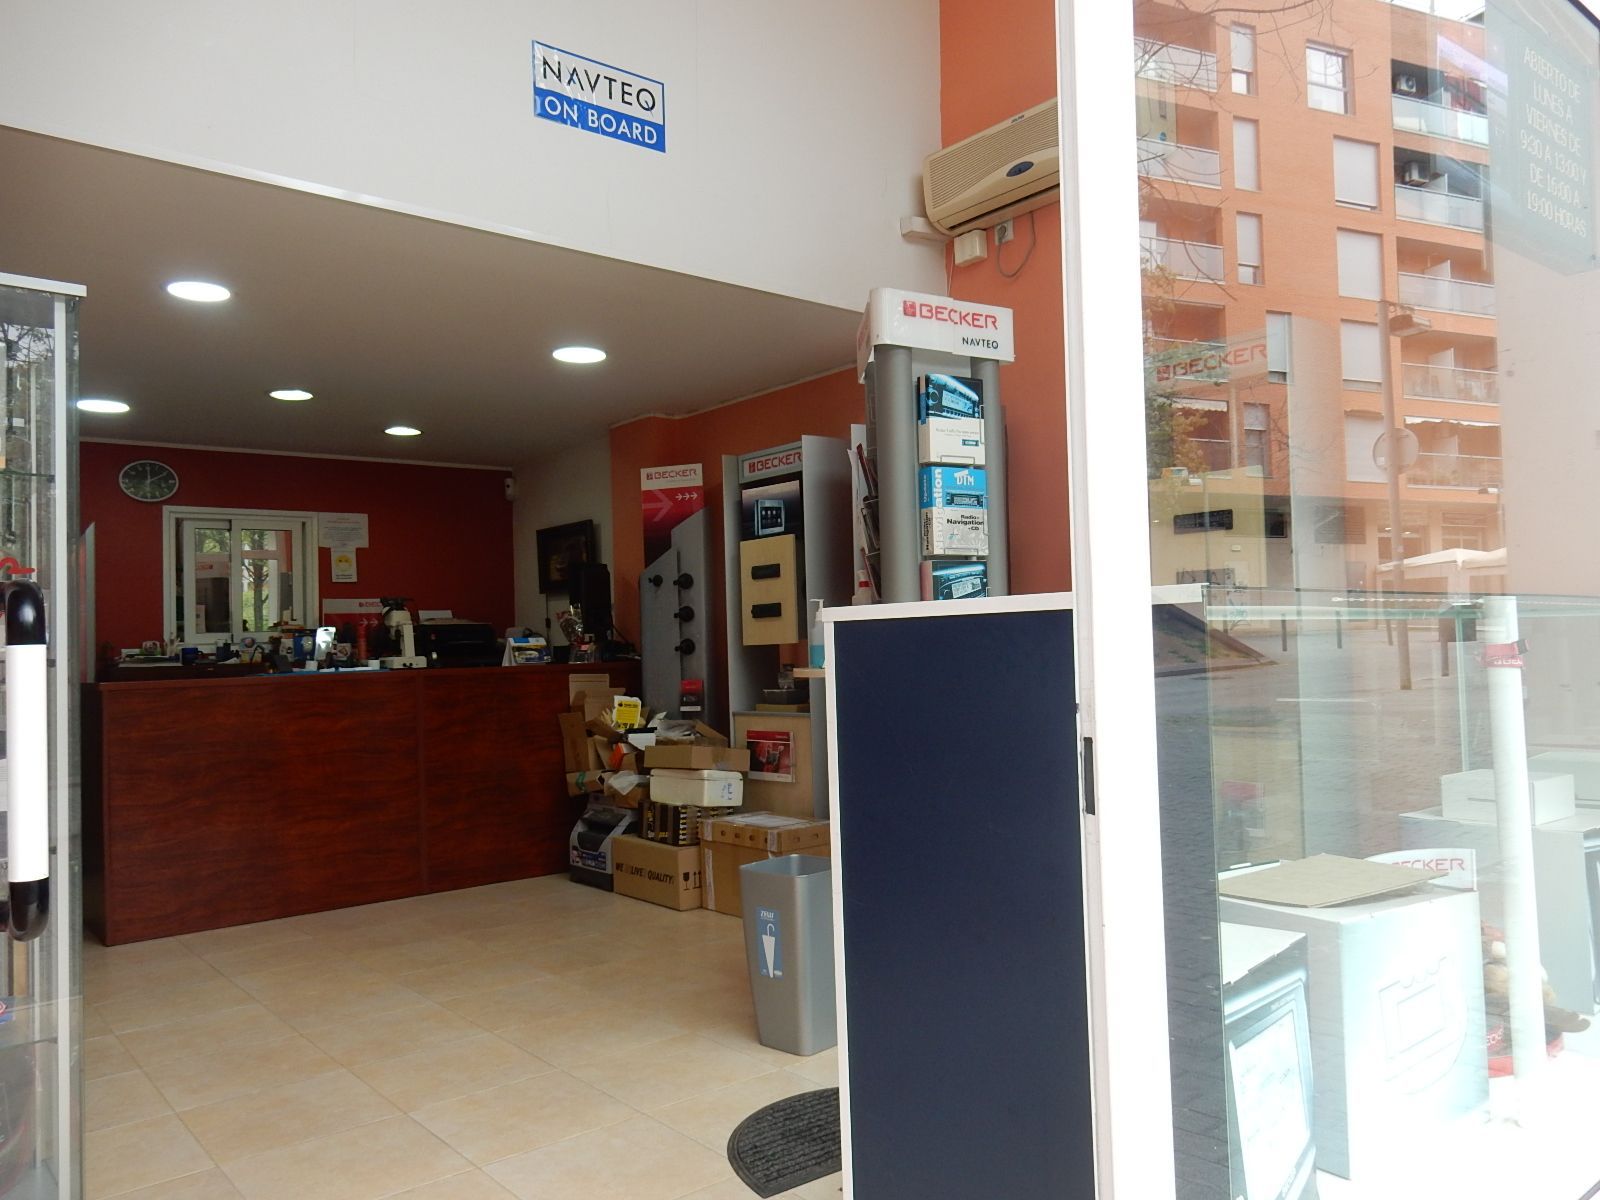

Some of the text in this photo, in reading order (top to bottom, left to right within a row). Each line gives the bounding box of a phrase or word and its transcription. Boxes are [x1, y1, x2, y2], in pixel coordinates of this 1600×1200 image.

[542, 55, 656, 116] NAVTEQ
[1523, 46, 1582, 103] ABIERTO DE
[1533, 79, 1574, 125] LUNES A
[544, 95, 657, 145] ON BOARD
[1525, 103, 1582, 157] VIERNES DE
[1544, 144, 1552, 166] A
[1529, 162, 1544, 188] DE
[1572, 189, 1582, 209] A
[1554, 205, 1586, 238] HORAS
[919, 303, 998, 330] BECKER
[1173, 344, 1267, 378] BECKER
[654, 468, 697, 480] BECKER
[757, 451, 802, 472] BECKER
[946, 518, 985, 526] Navigation
[1391, 857, 1466, 872] CKER
